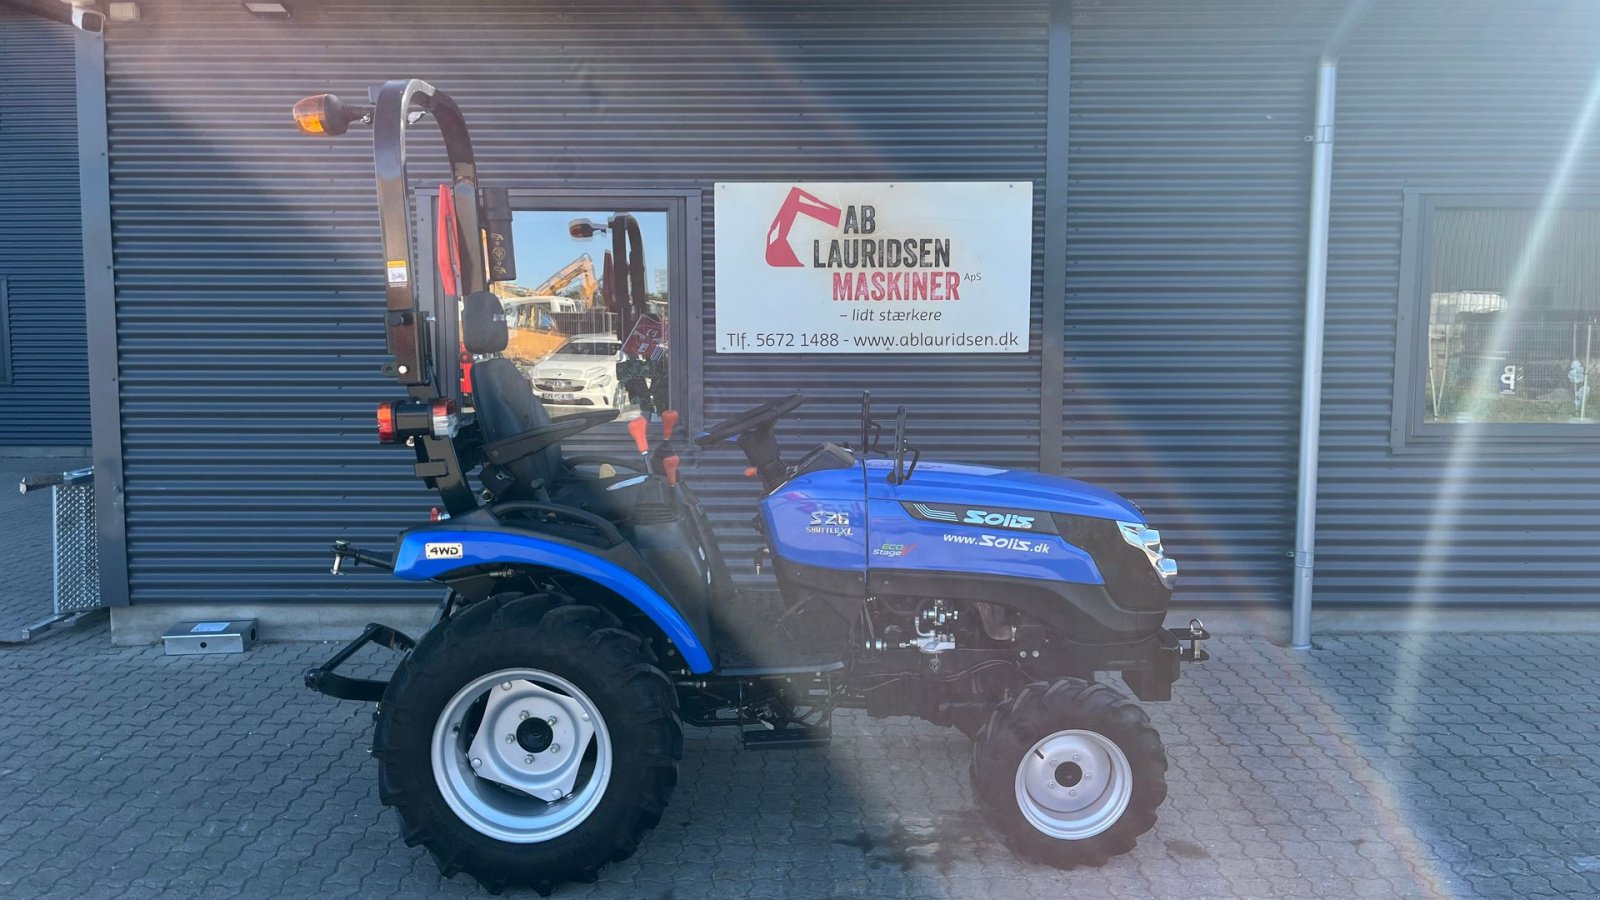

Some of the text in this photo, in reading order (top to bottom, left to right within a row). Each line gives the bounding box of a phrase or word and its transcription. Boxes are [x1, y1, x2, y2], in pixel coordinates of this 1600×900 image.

[843, 205, 876, 235] AB
[813, 238, 950, 268] LAURIDSEN
[832, 271, 982, 301] MASKINER ApS
[852, 309, 875, 322] lidt
[879, 309, 942, 321] stærkere
[727, 333, 751, 350] Tlf.
[756, 333, 794, 347] 5672
[801, 333, 839, 347] 1488
[853, 331, 1019, 347] www.ablauridsen.dk
[430, 547, 459, 555] 4WD
